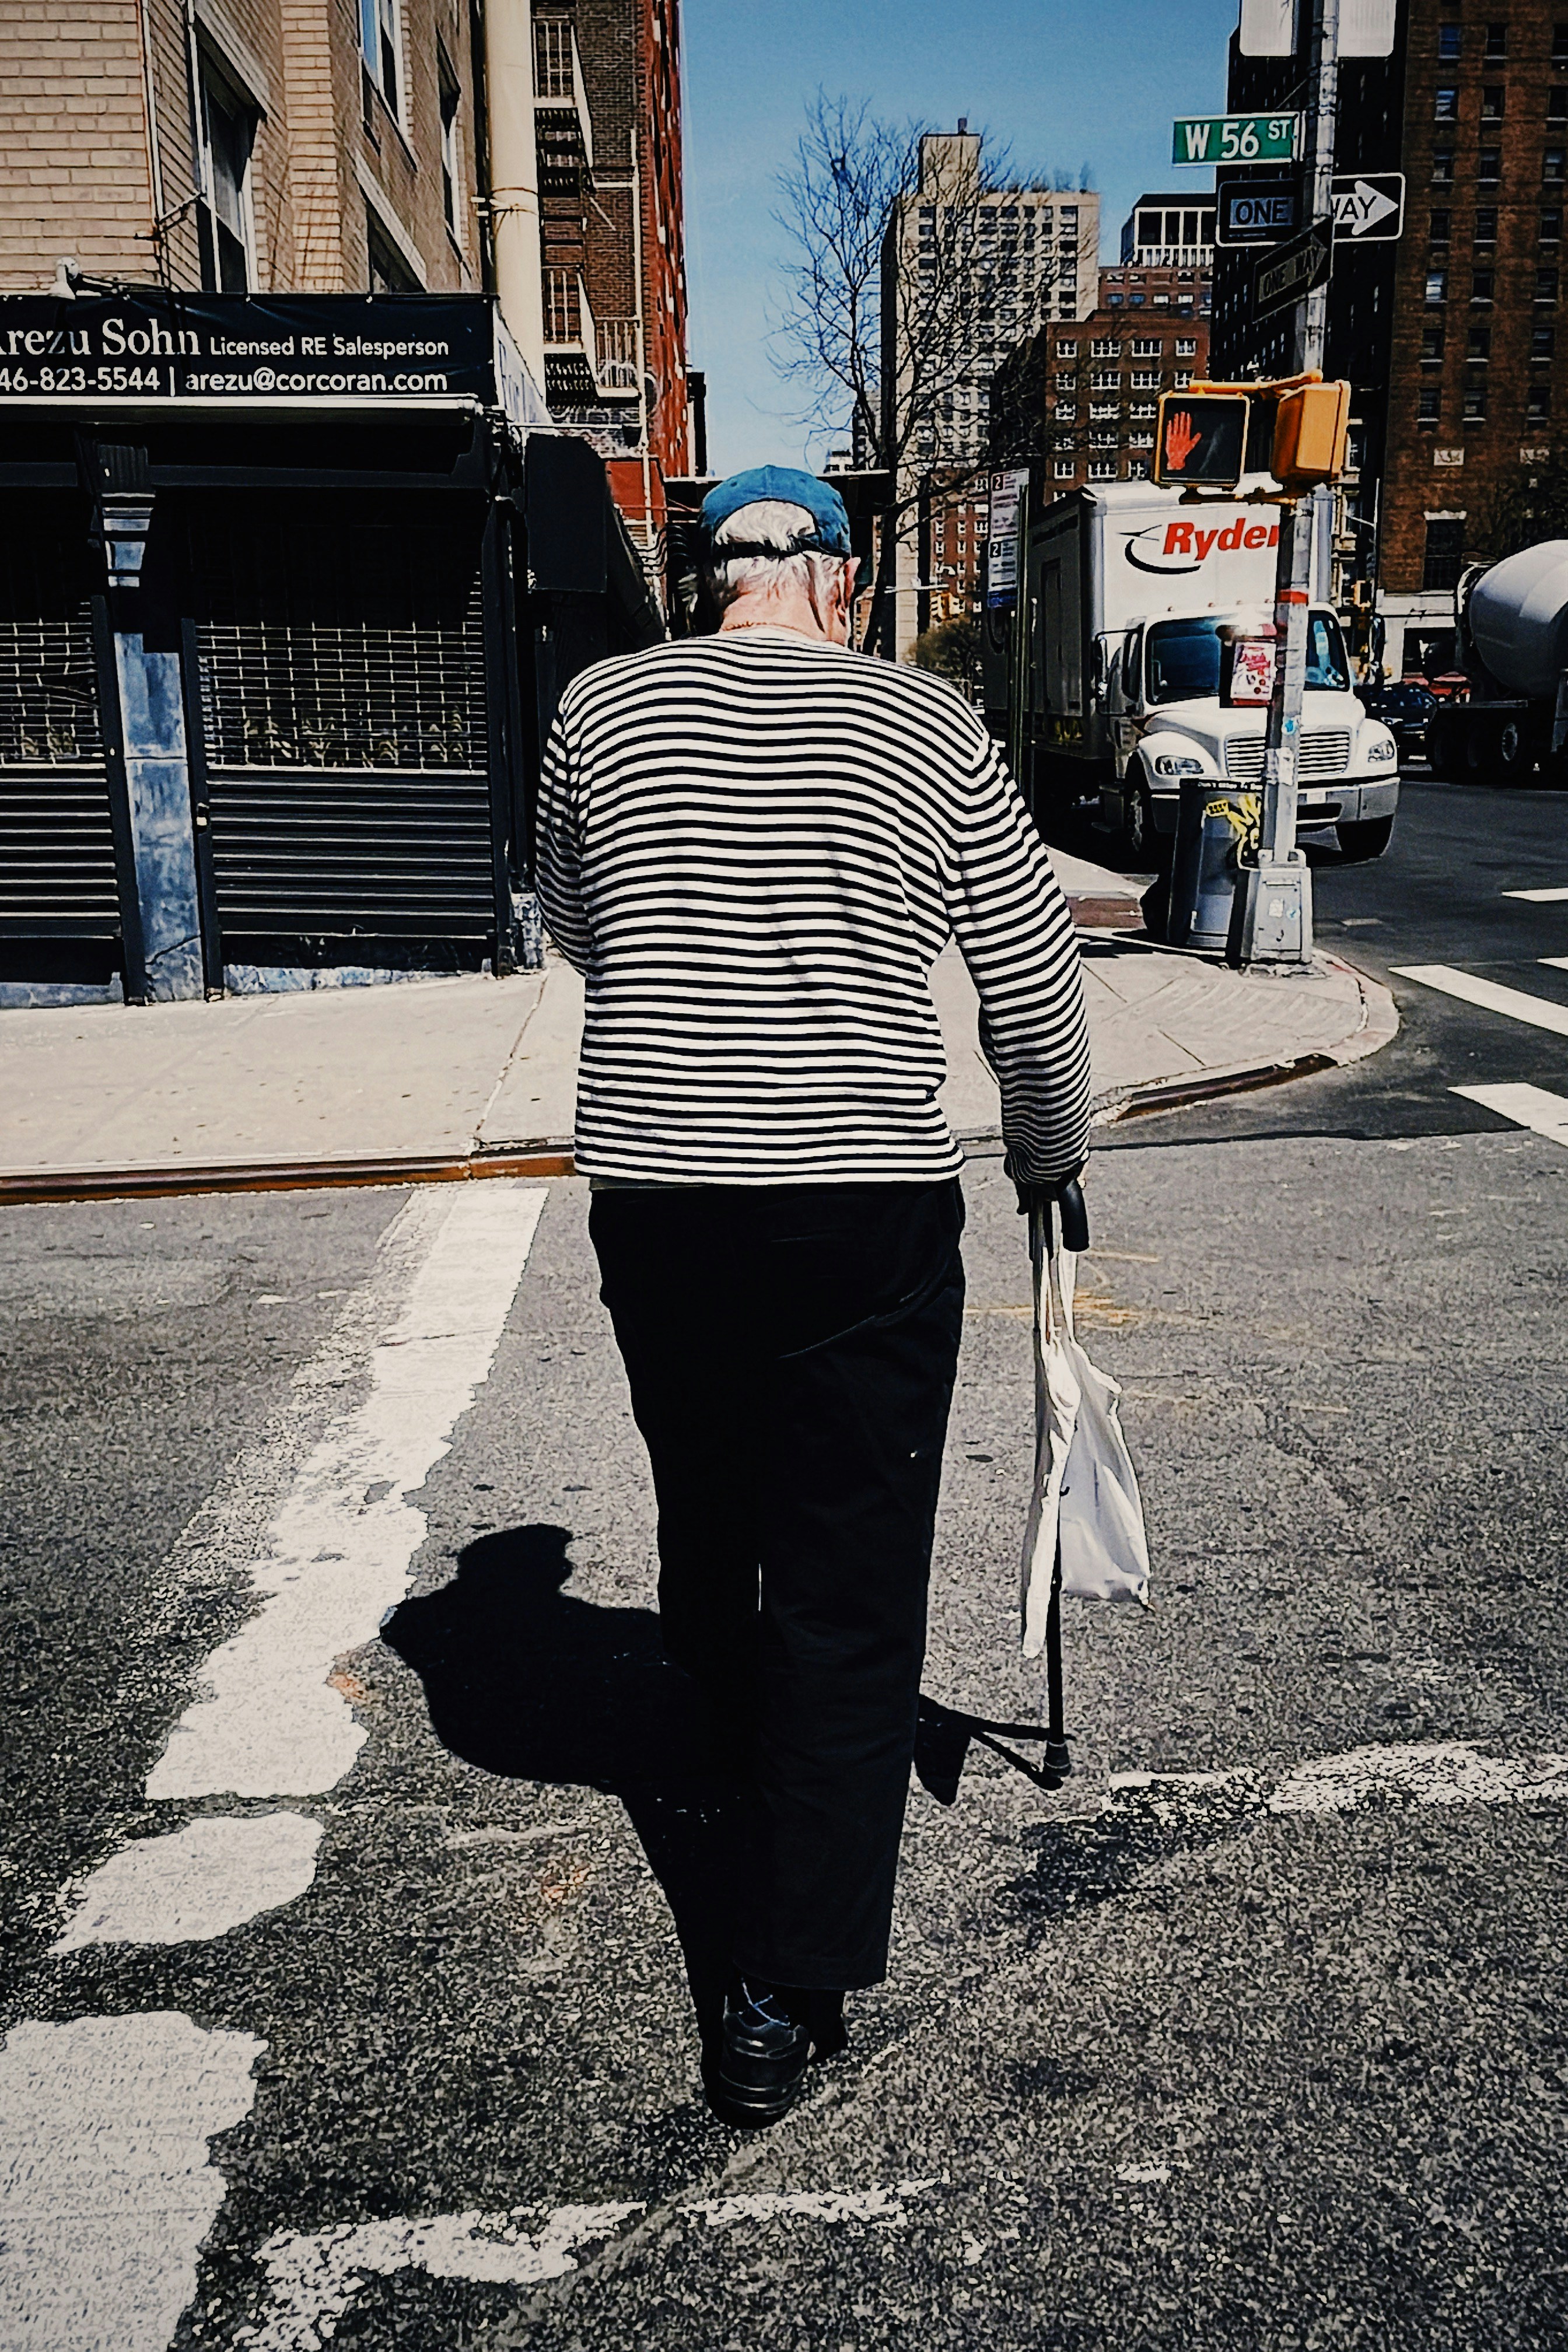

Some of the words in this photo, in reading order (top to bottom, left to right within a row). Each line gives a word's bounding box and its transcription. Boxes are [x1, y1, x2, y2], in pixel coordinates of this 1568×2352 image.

[1185, 123, 1210, 160] W
[1221, 121, 1259, 159] 56
[1268, 120, 1290, 140] ST
[1235, 200, 1289, 225] ONE
[1264, 264, 1287, 297] ONE
[0, 330, 91, 355] rezu
[102, 318, 201, 355] Sohn
[210, 336, 294, 355] Licensed
[302, 337, 327, 355] RE
[333, 335, 449, 360] Salesperson
[186, 366, 447, 391] arezu@corcoran.com
